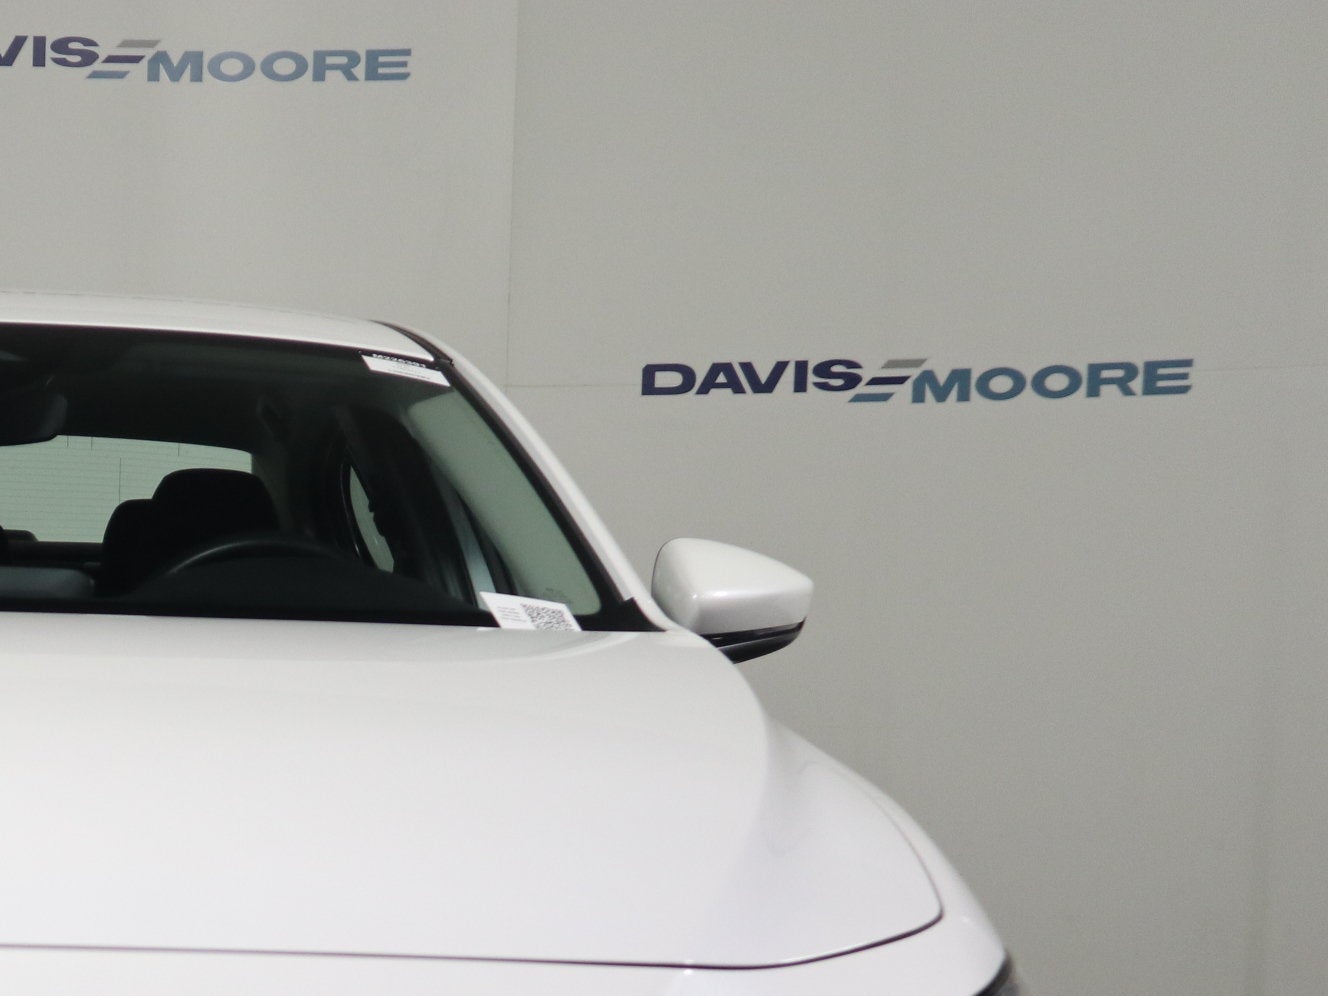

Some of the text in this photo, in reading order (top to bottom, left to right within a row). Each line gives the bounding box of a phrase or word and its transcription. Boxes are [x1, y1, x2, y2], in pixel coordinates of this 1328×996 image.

[146, 48, 412, 83] MOORE
[641, 358, 1194, 404] DAVIS MOORE
